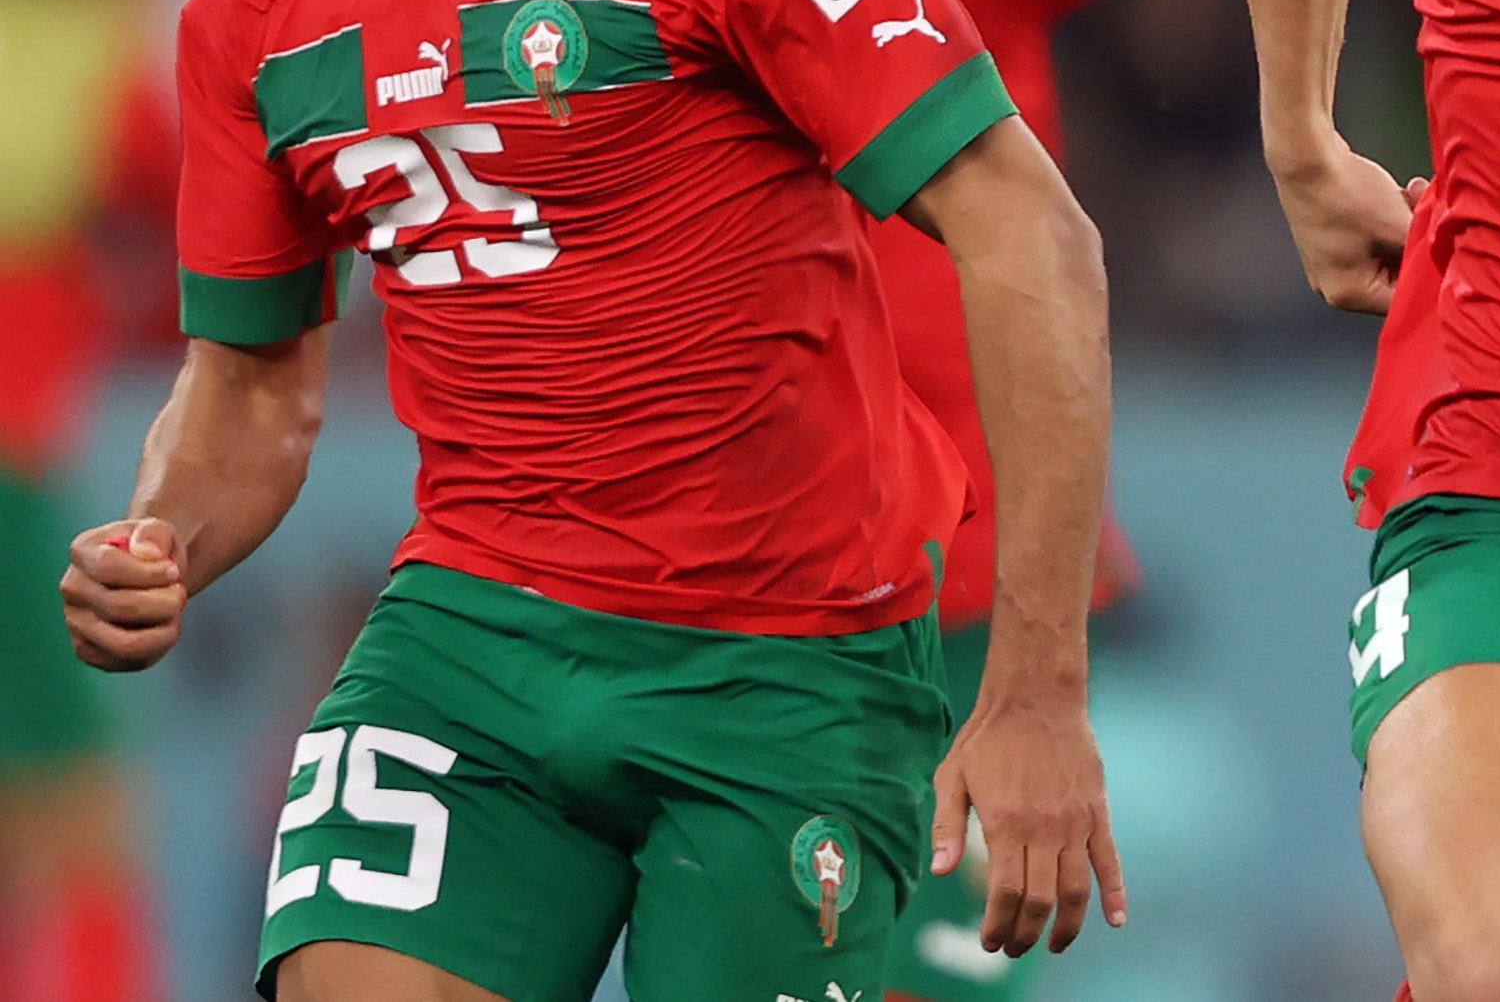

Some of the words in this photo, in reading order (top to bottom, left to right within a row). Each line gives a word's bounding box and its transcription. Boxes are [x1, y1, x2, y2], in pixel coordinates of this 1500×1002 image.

[377, 67, 444, 106] PUMA
[332, 122, 561, 286] 25
[1348, 568, 1410, 688] 4
[266, 723, 458, 918] 25
